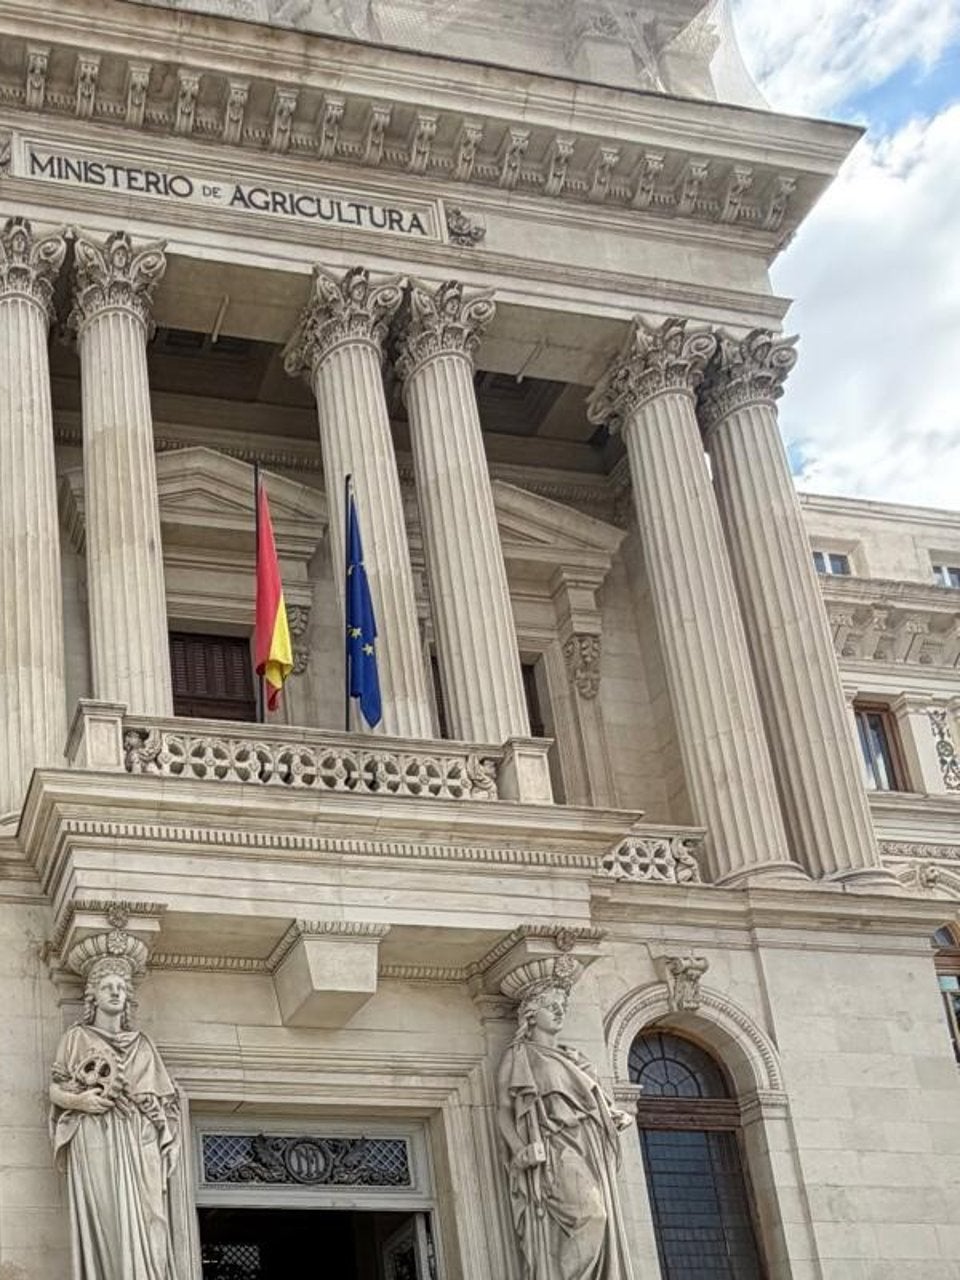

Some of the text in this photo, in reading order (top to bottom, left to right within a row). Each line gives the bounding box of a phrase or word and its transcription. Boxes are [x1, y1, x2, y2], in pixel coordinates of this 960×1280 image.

[29, 152, 427, 236] MINISTERIO DE AGRICULTURA
